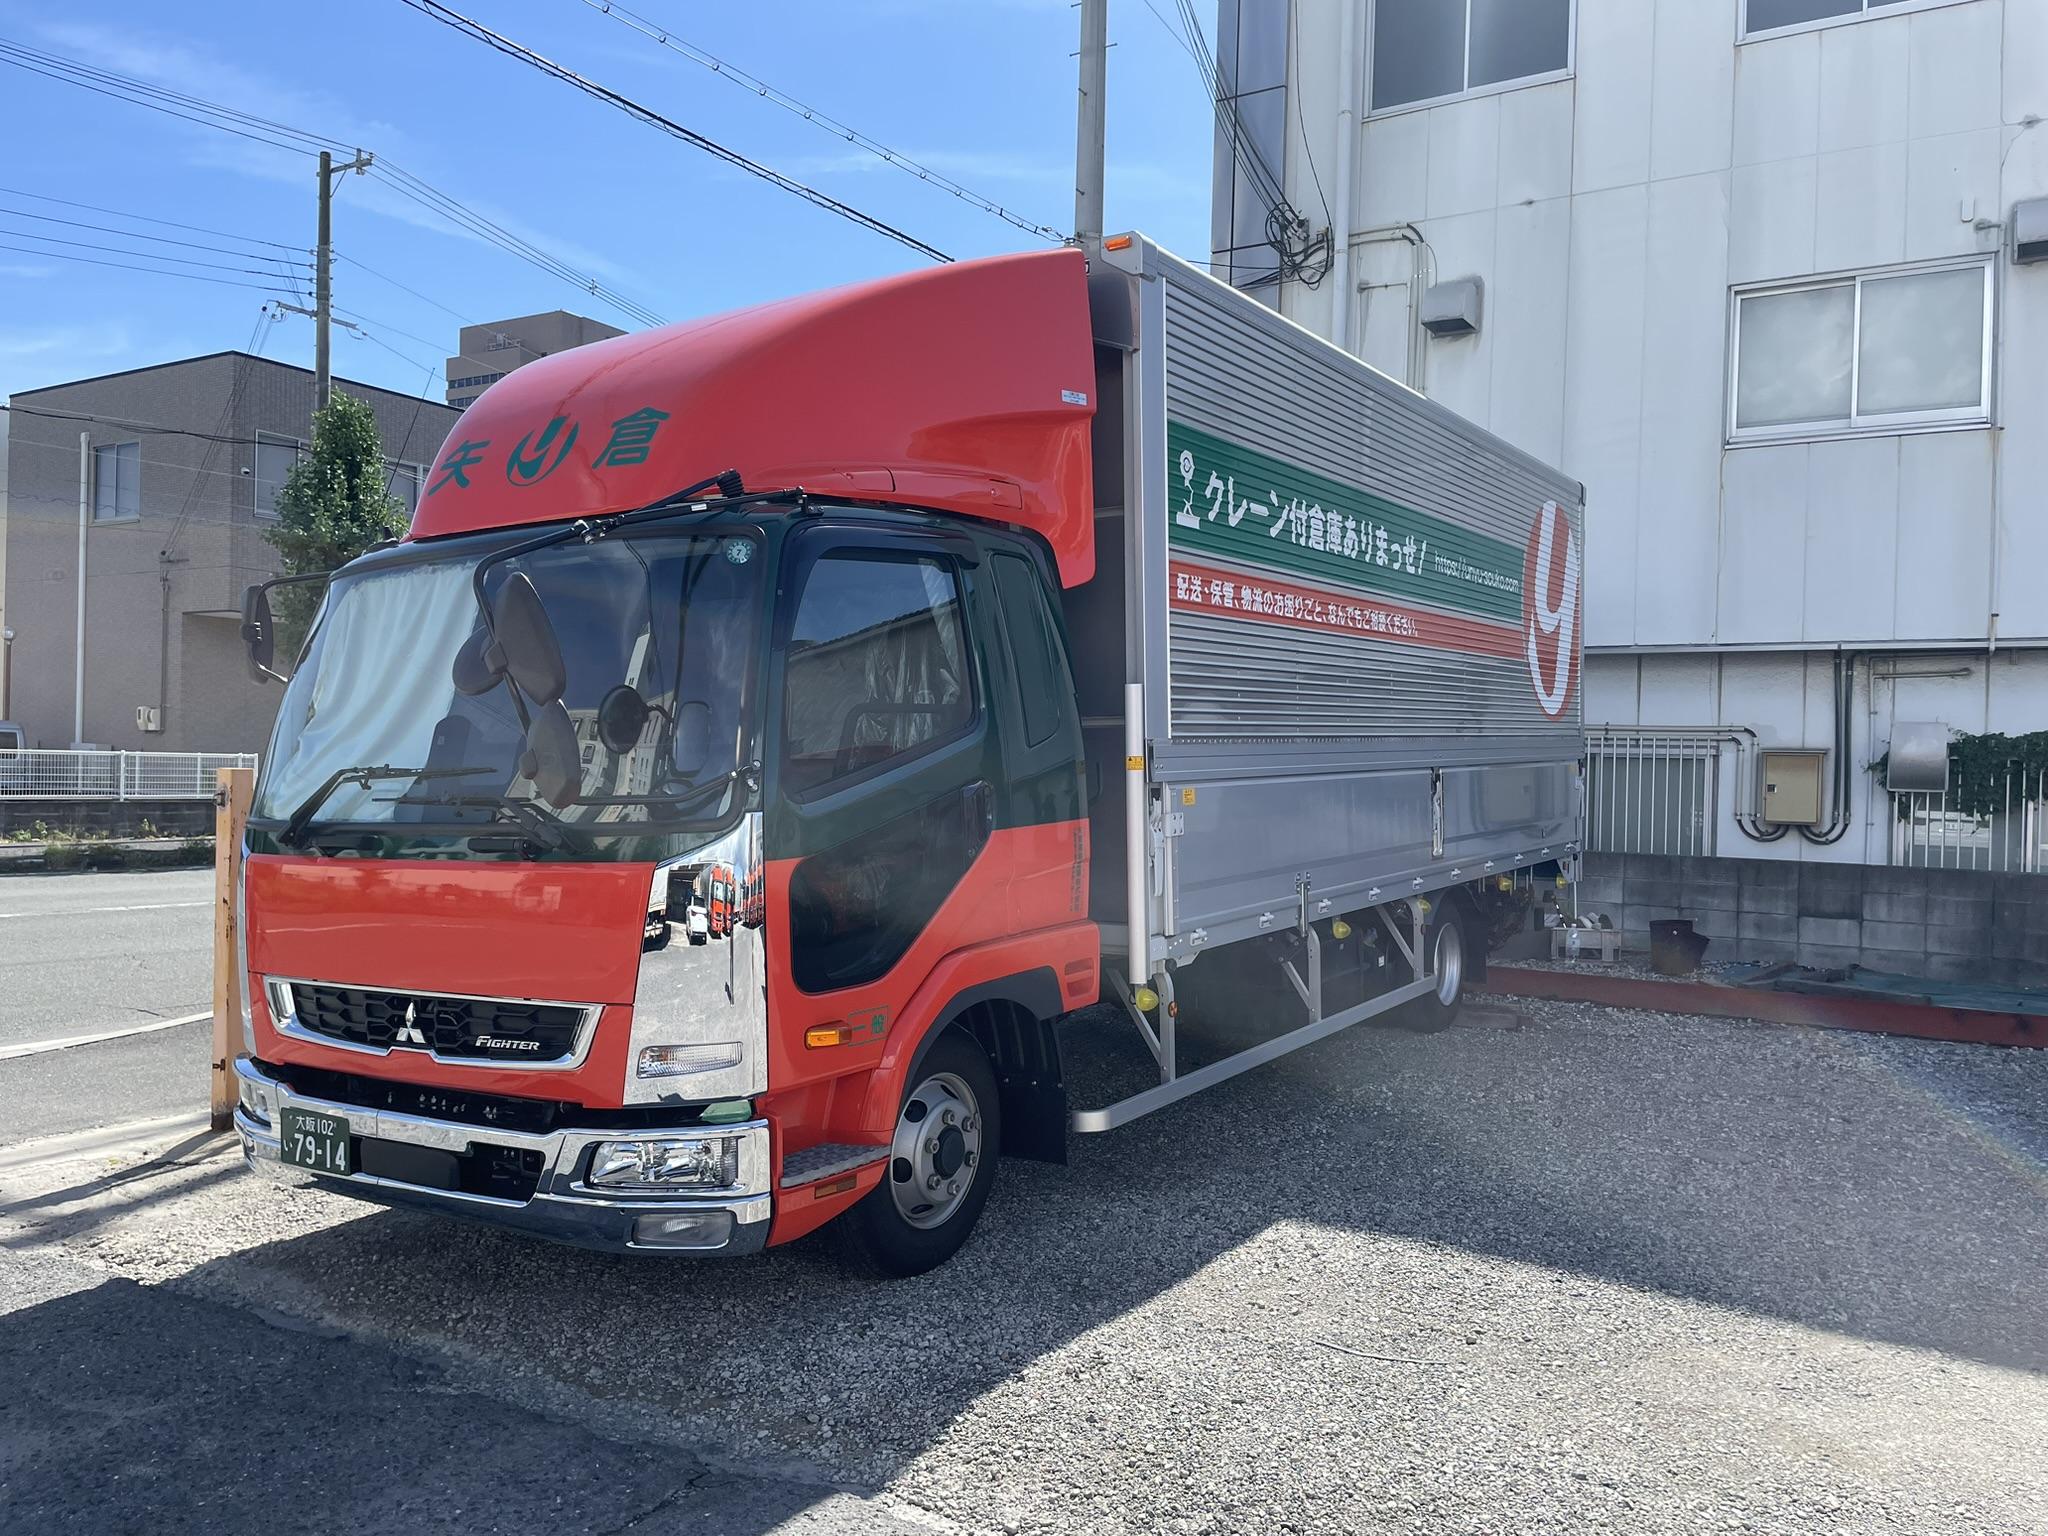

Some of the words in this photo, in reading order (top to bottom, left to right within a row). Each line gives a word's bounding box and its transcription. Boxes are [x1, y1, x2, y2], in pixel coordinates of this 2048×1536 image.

[428, 439, 490, 496] 矢
[591, 406, 671, 469] 倉
[475, 1035, 540, 1050] FIGHTER
[283, 1139, 293, 1152] い
[294, 1133, 346, 1171] 79-14
